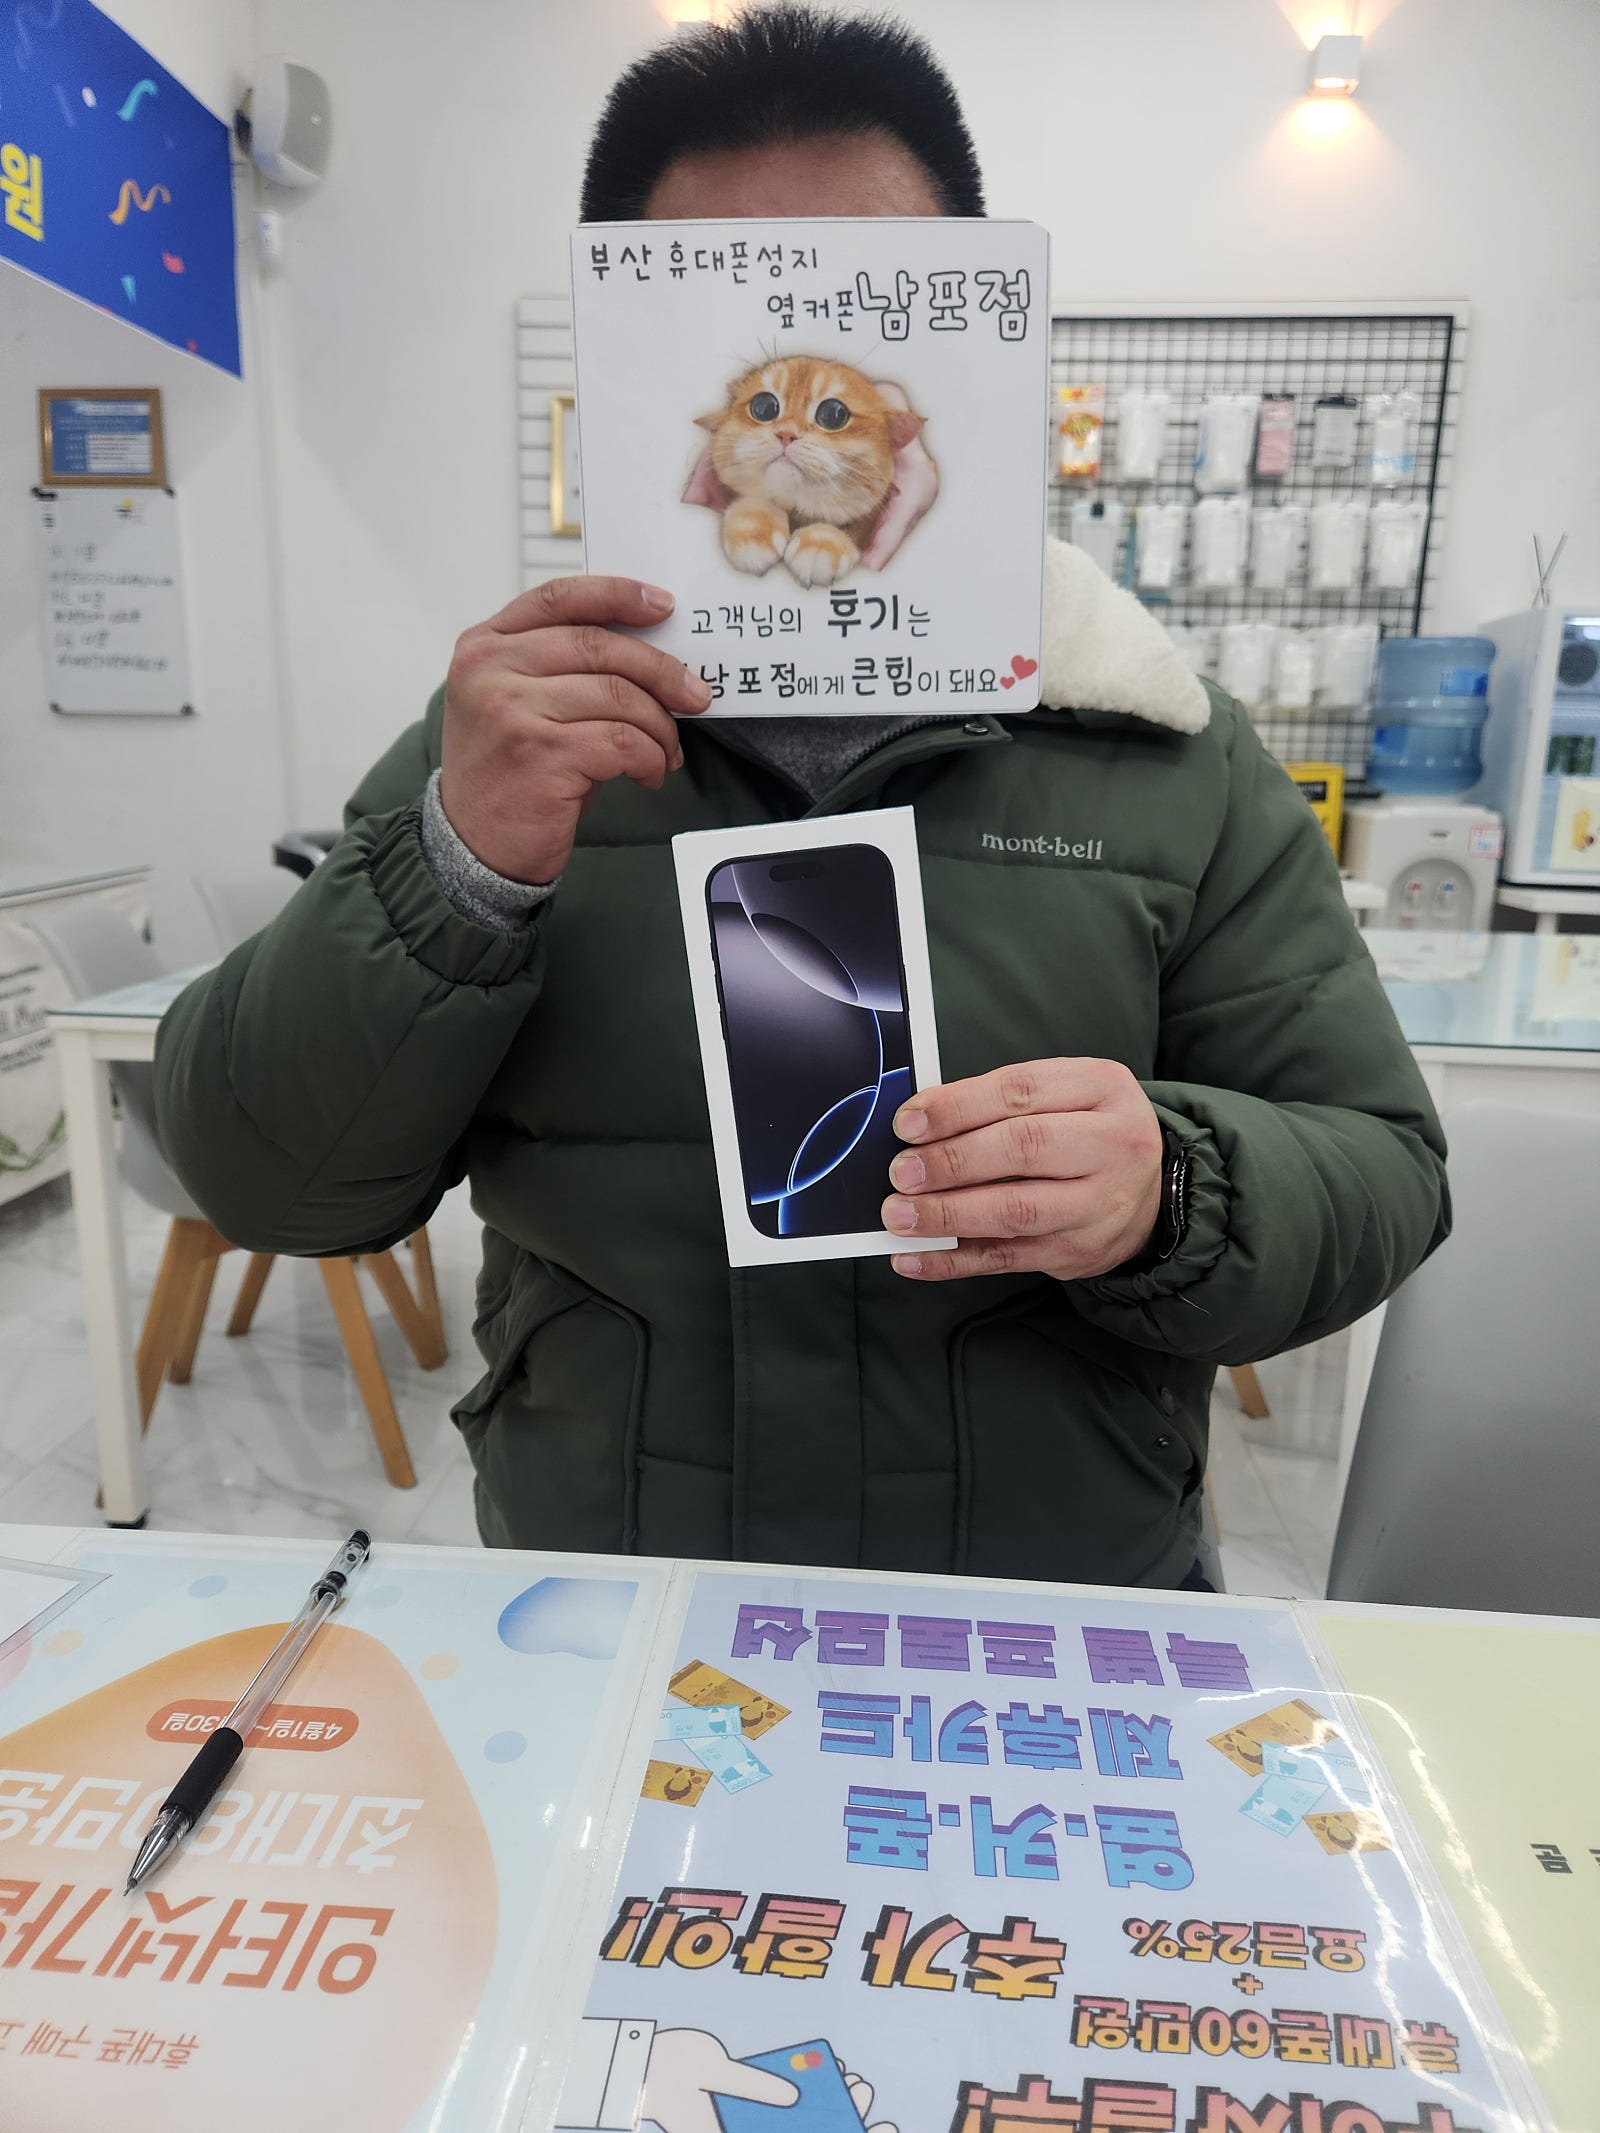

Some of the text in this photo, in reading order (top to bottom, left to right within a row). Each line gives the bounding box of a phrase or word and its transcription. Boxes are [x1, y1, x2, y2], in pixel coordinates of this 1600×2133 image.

[589, 243, 653, 281] 부산
[690, 588, 932, 639] 고객님의 후기는
[949, 668, 999, 693] 돼요
[731, 1603, 1254, 1692] 특별 프로모션
[599, 1887, 1067, 2001] 추가 할인!
[20, 2021, 91, 2059] 구매
[96, 2026, 200, 2070] 휴대폰
